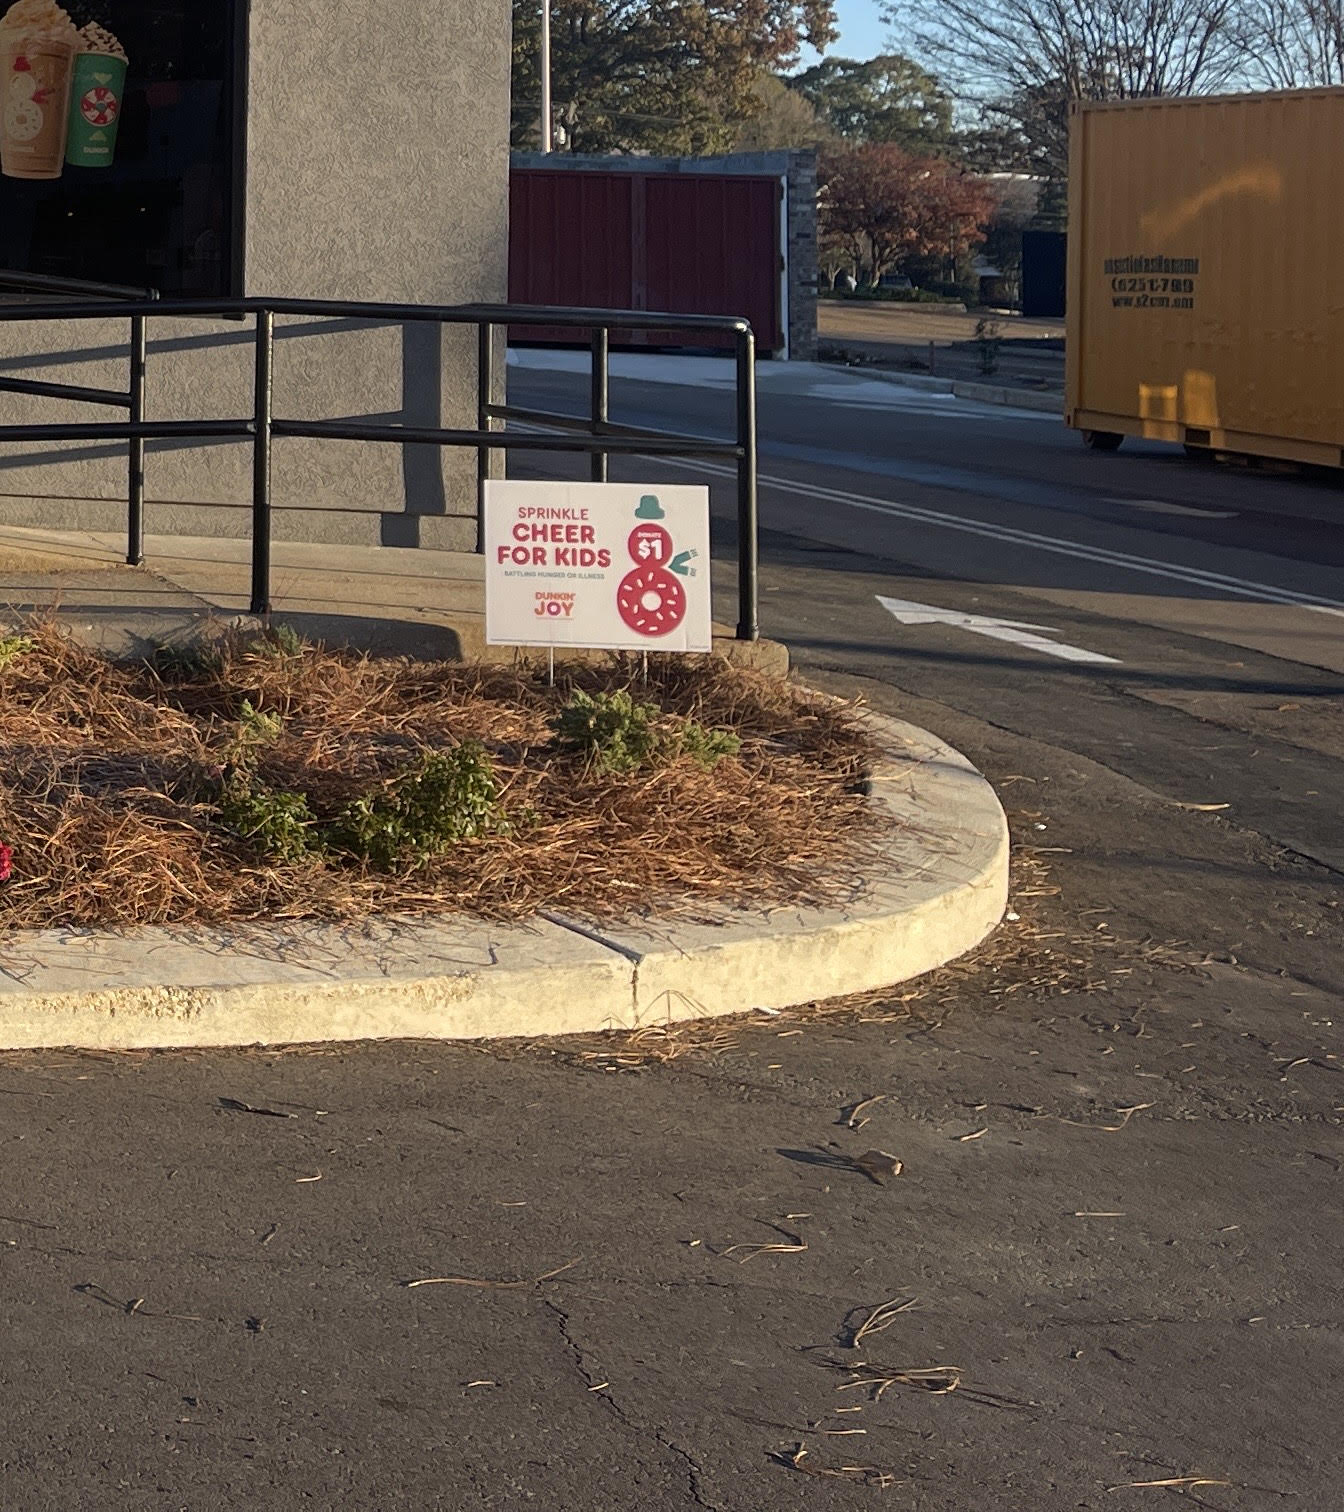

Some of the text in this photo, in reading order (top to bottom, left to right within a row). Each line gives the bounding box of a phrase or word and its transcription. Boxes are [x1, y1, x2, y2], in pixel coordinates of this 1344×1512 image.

[518, 506, 589, 520] SPRINKLE
[512, 523, 595, 544] CHEER
[497, 545, 611, 568] FOR KIDS
[638, 539, 663, 560] $1
[535, 592, 576, 601] DUNKIN'
[534, 601, 574, 616] JOY
